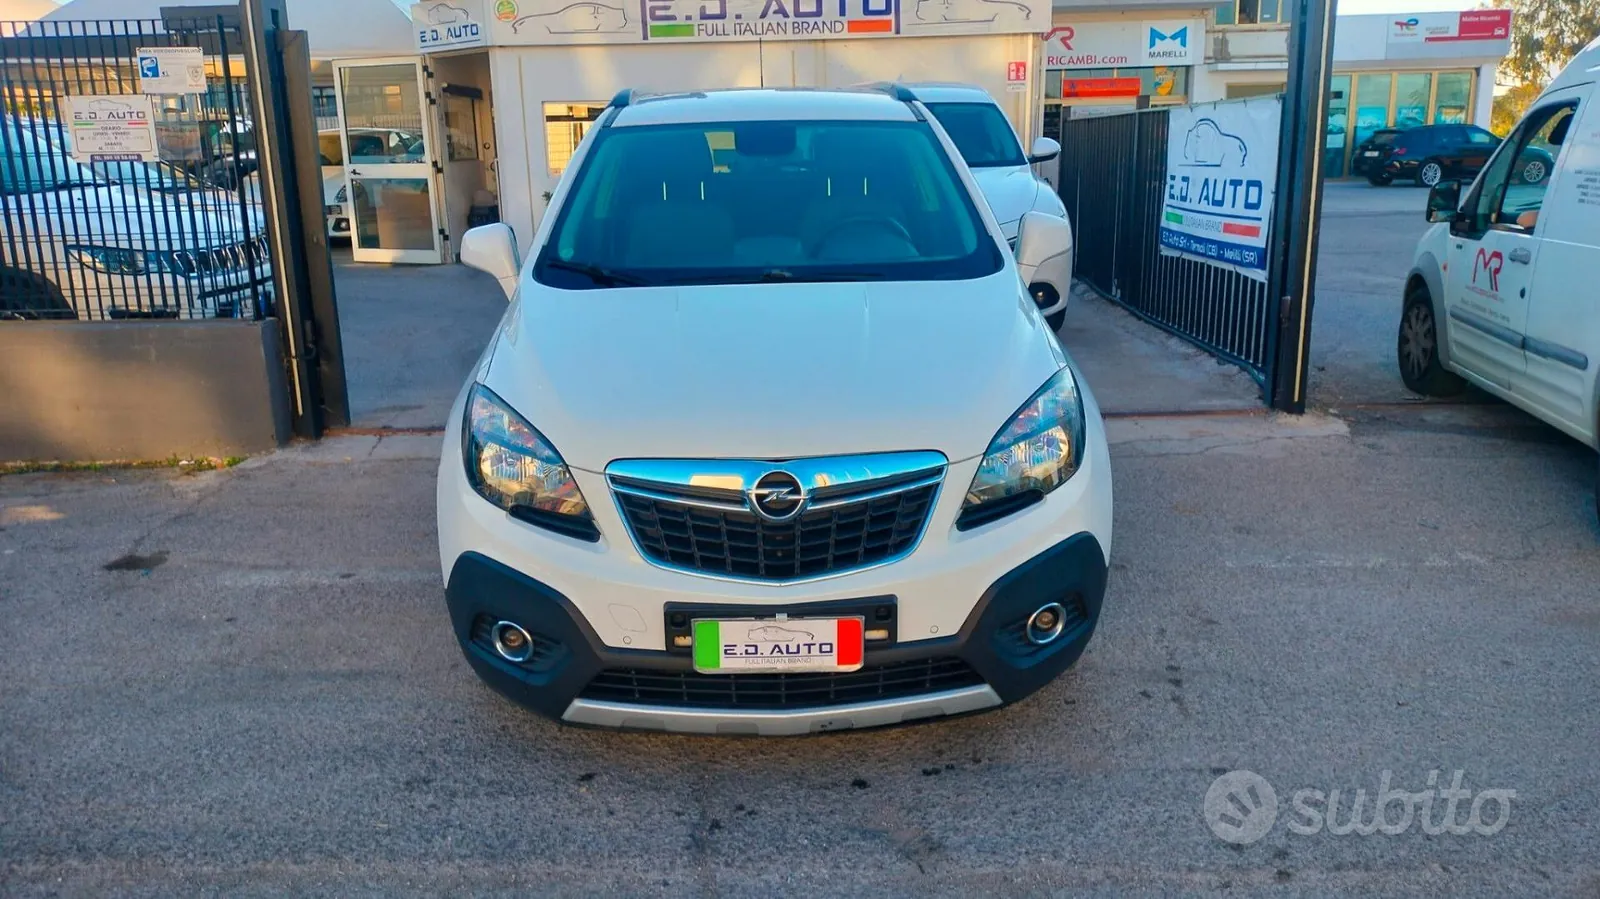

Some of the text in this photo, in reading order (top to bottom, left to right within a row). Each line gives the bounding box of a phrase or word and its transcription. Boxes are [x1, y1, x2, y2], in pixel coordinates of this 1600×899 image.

[759, 0, 892, 18] AUTO
[420, 24, 479, 43] E.D. AUTO
[697, 20, 845, 37] FULL ITALIAN BRAND
[1047, 54, 1128, 66] RICAMBI.com
[1148, 51, 1187, 59] MARELLI
[107, 111, 146, 119] AUTO
[1198, 178, 1262, 210] AUTO
[1242, 249, 1258, 265] (SR)
[724, 642, 834, 656] E.D. AUTO
[788, 656, 812, 664] BRAND
